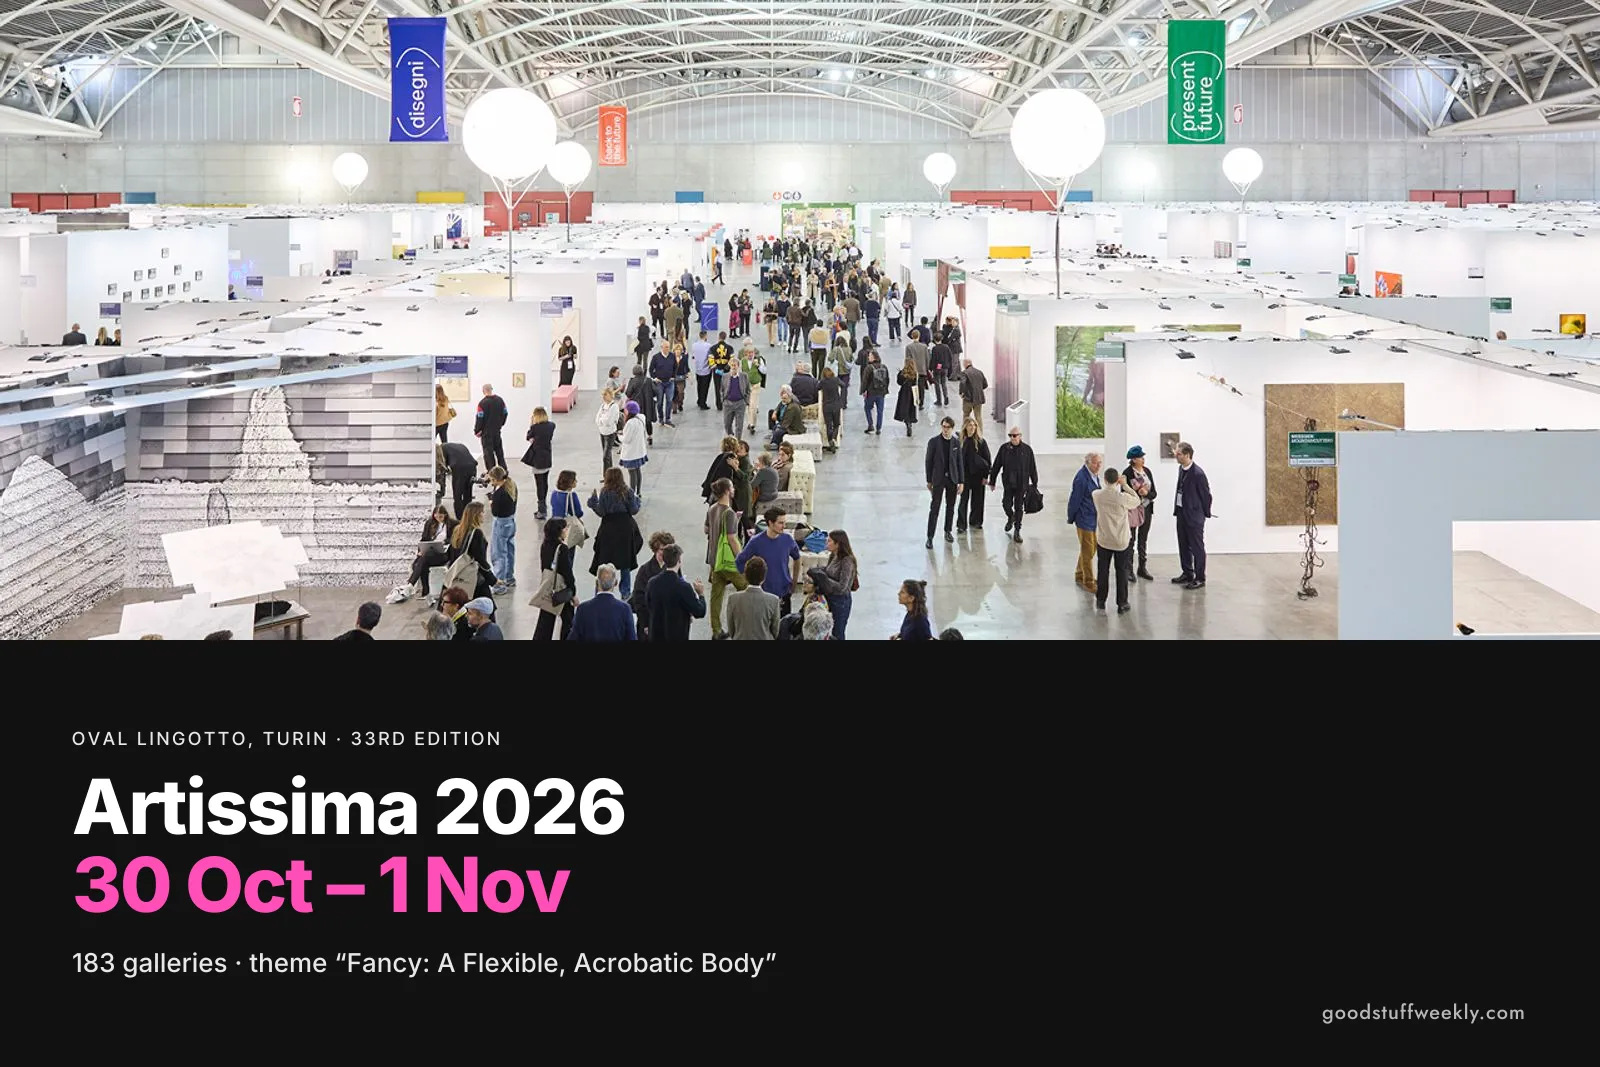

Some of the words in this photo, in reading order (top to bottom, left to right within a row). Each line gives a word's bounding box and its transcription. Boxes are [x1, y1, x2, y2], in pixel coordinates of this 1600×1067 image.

[408, 61, 428, 129] disegni
[1181, 61, 1197, 131] present
[1197, 77, 1213, 132] future
[604, 125, 613, 136] to
[613, 116, 621, 143] future
[604, 137, 613, 160] back
[613, 144, 621, 160] the
